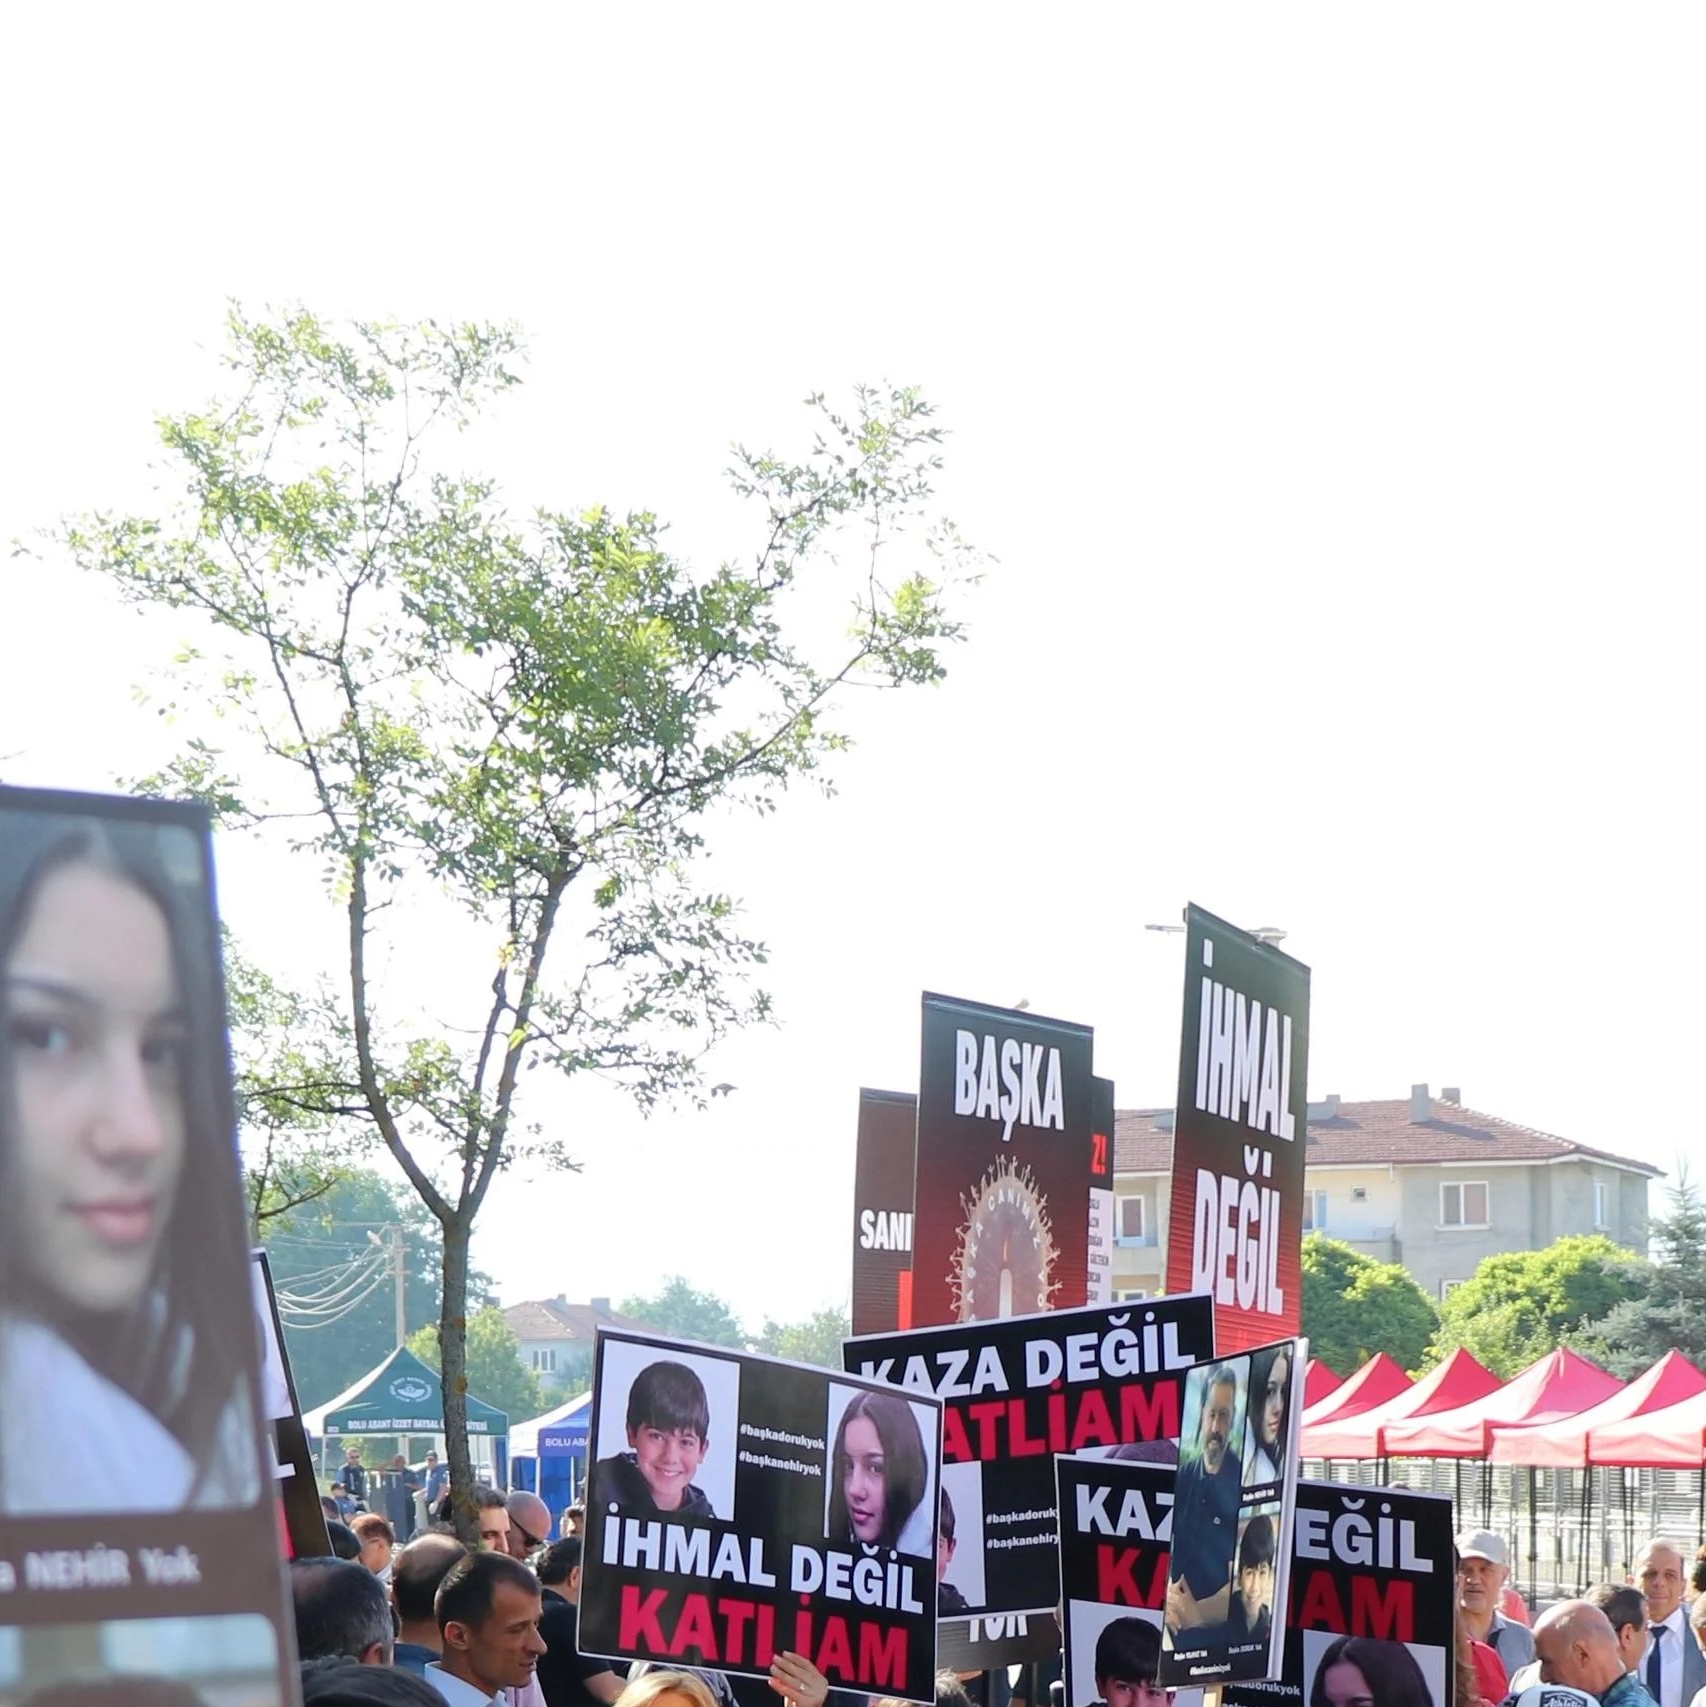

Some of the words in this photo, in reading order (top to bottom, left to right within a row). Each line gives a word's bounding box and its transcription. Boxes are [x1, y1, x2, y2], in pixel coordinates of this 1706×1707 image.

[1195, 937, 1295, 1142] İHMAL
[954, 1028, 1065, 1142] BAŞKA
[1193, 1143, 1284, 1316] DEĞİL
[860, 1345, 1010, 1399] KAZA
[1024, 1311, 1196, 1389] DEĞİL
[545, 1437, 571, 1447] BOLU
[738, 1450, 822, 1477] #başkanehiryok
[739, 1423, 825, 1451] #başkadorukyok
[943, 1379, 1181, 1464] ATLİAM
[603, 1502, 776, 1588] İHMAL
[790, 1542, 924, 1615] DEĞİL
[986, 1507, 1058, 1525] #başkadoruk
[1295, 1496, 1434, 1573] EĞİL
[25, 1542, 132, 1590] NEHİR
[139, 1545, 202, 1584] Yok
[618, 1583, 910, 1691] KATLİAM
